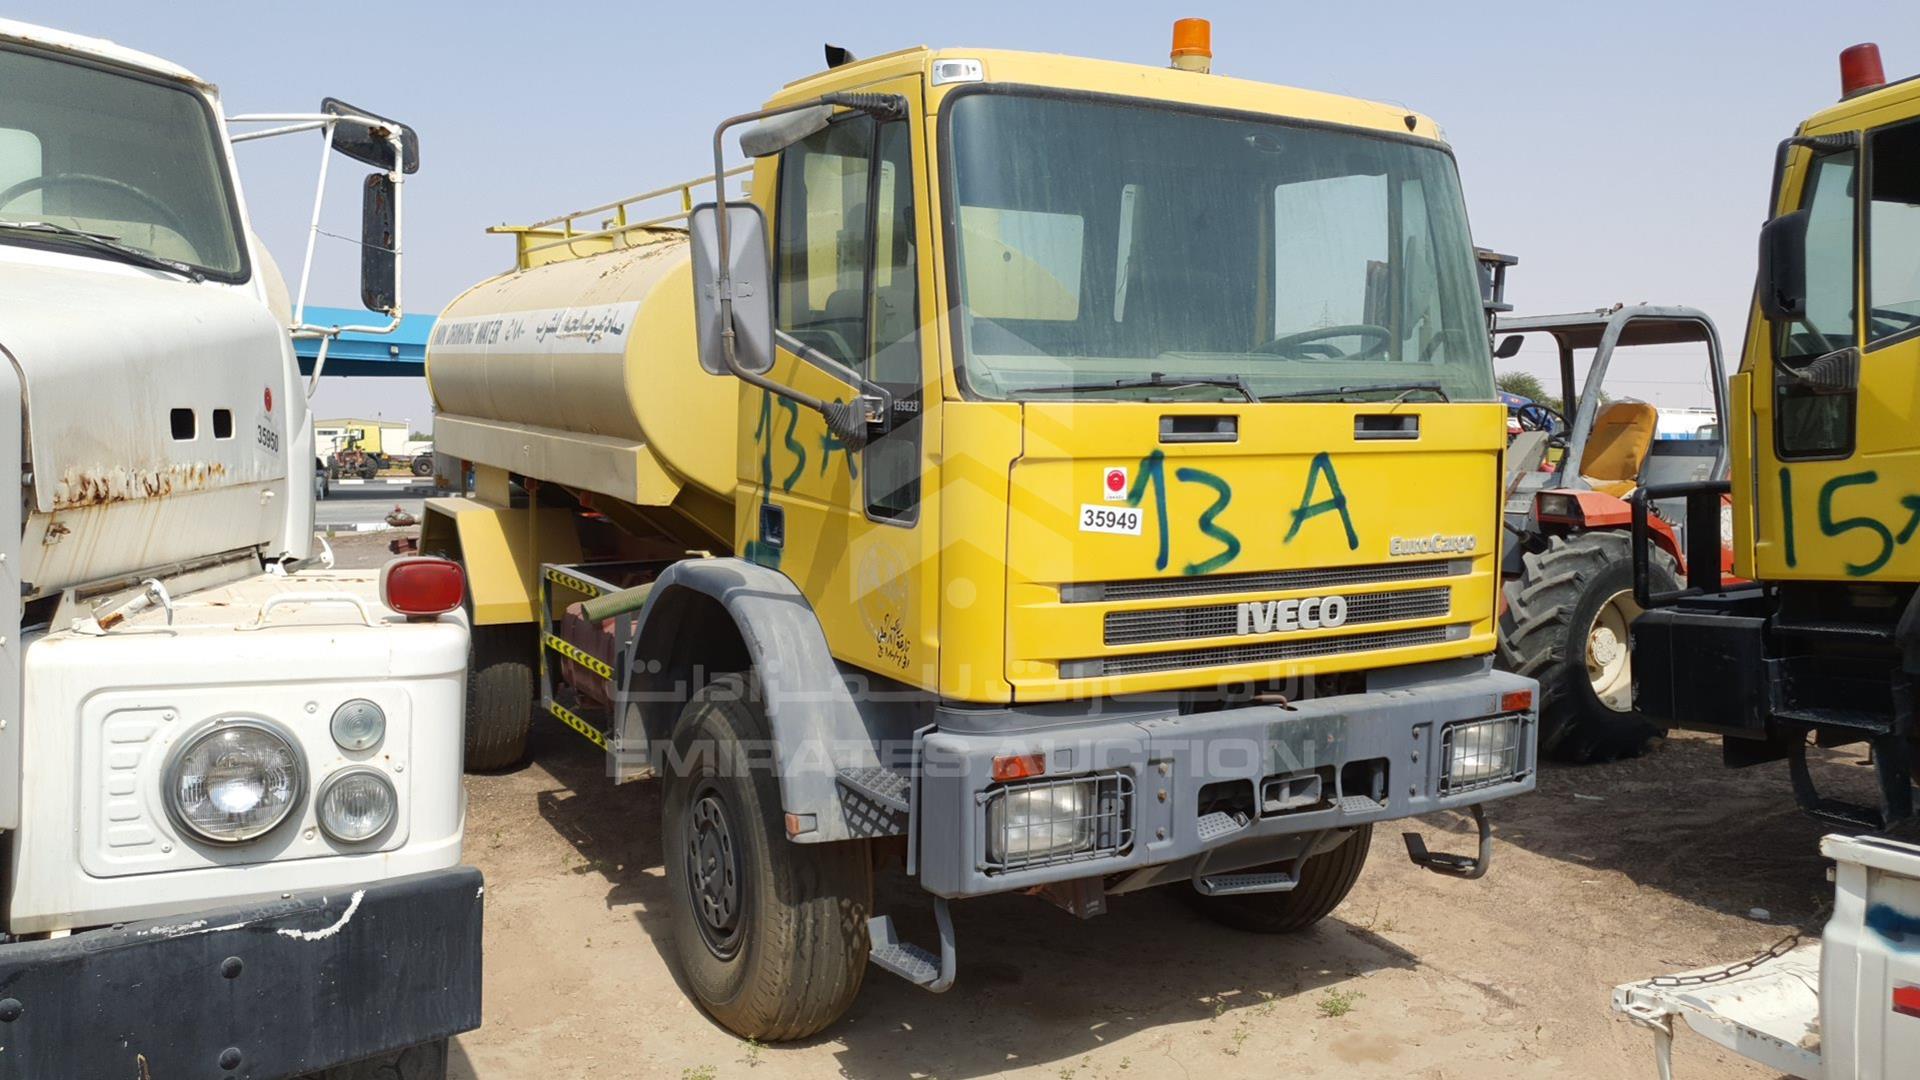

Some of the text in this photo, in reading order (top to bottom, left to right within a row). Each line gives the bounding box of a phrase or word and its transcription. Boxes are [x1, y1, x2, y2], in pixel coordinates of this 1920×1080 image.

[257, 424, 279, 453] 35950
[1083, 508, 1138, 530] 35949
[1126, 449, 1359, 576] 13 A
[1390, 534, 1477, 556] EuroCargo
[1236, 595, 1348, 635] IVECO
